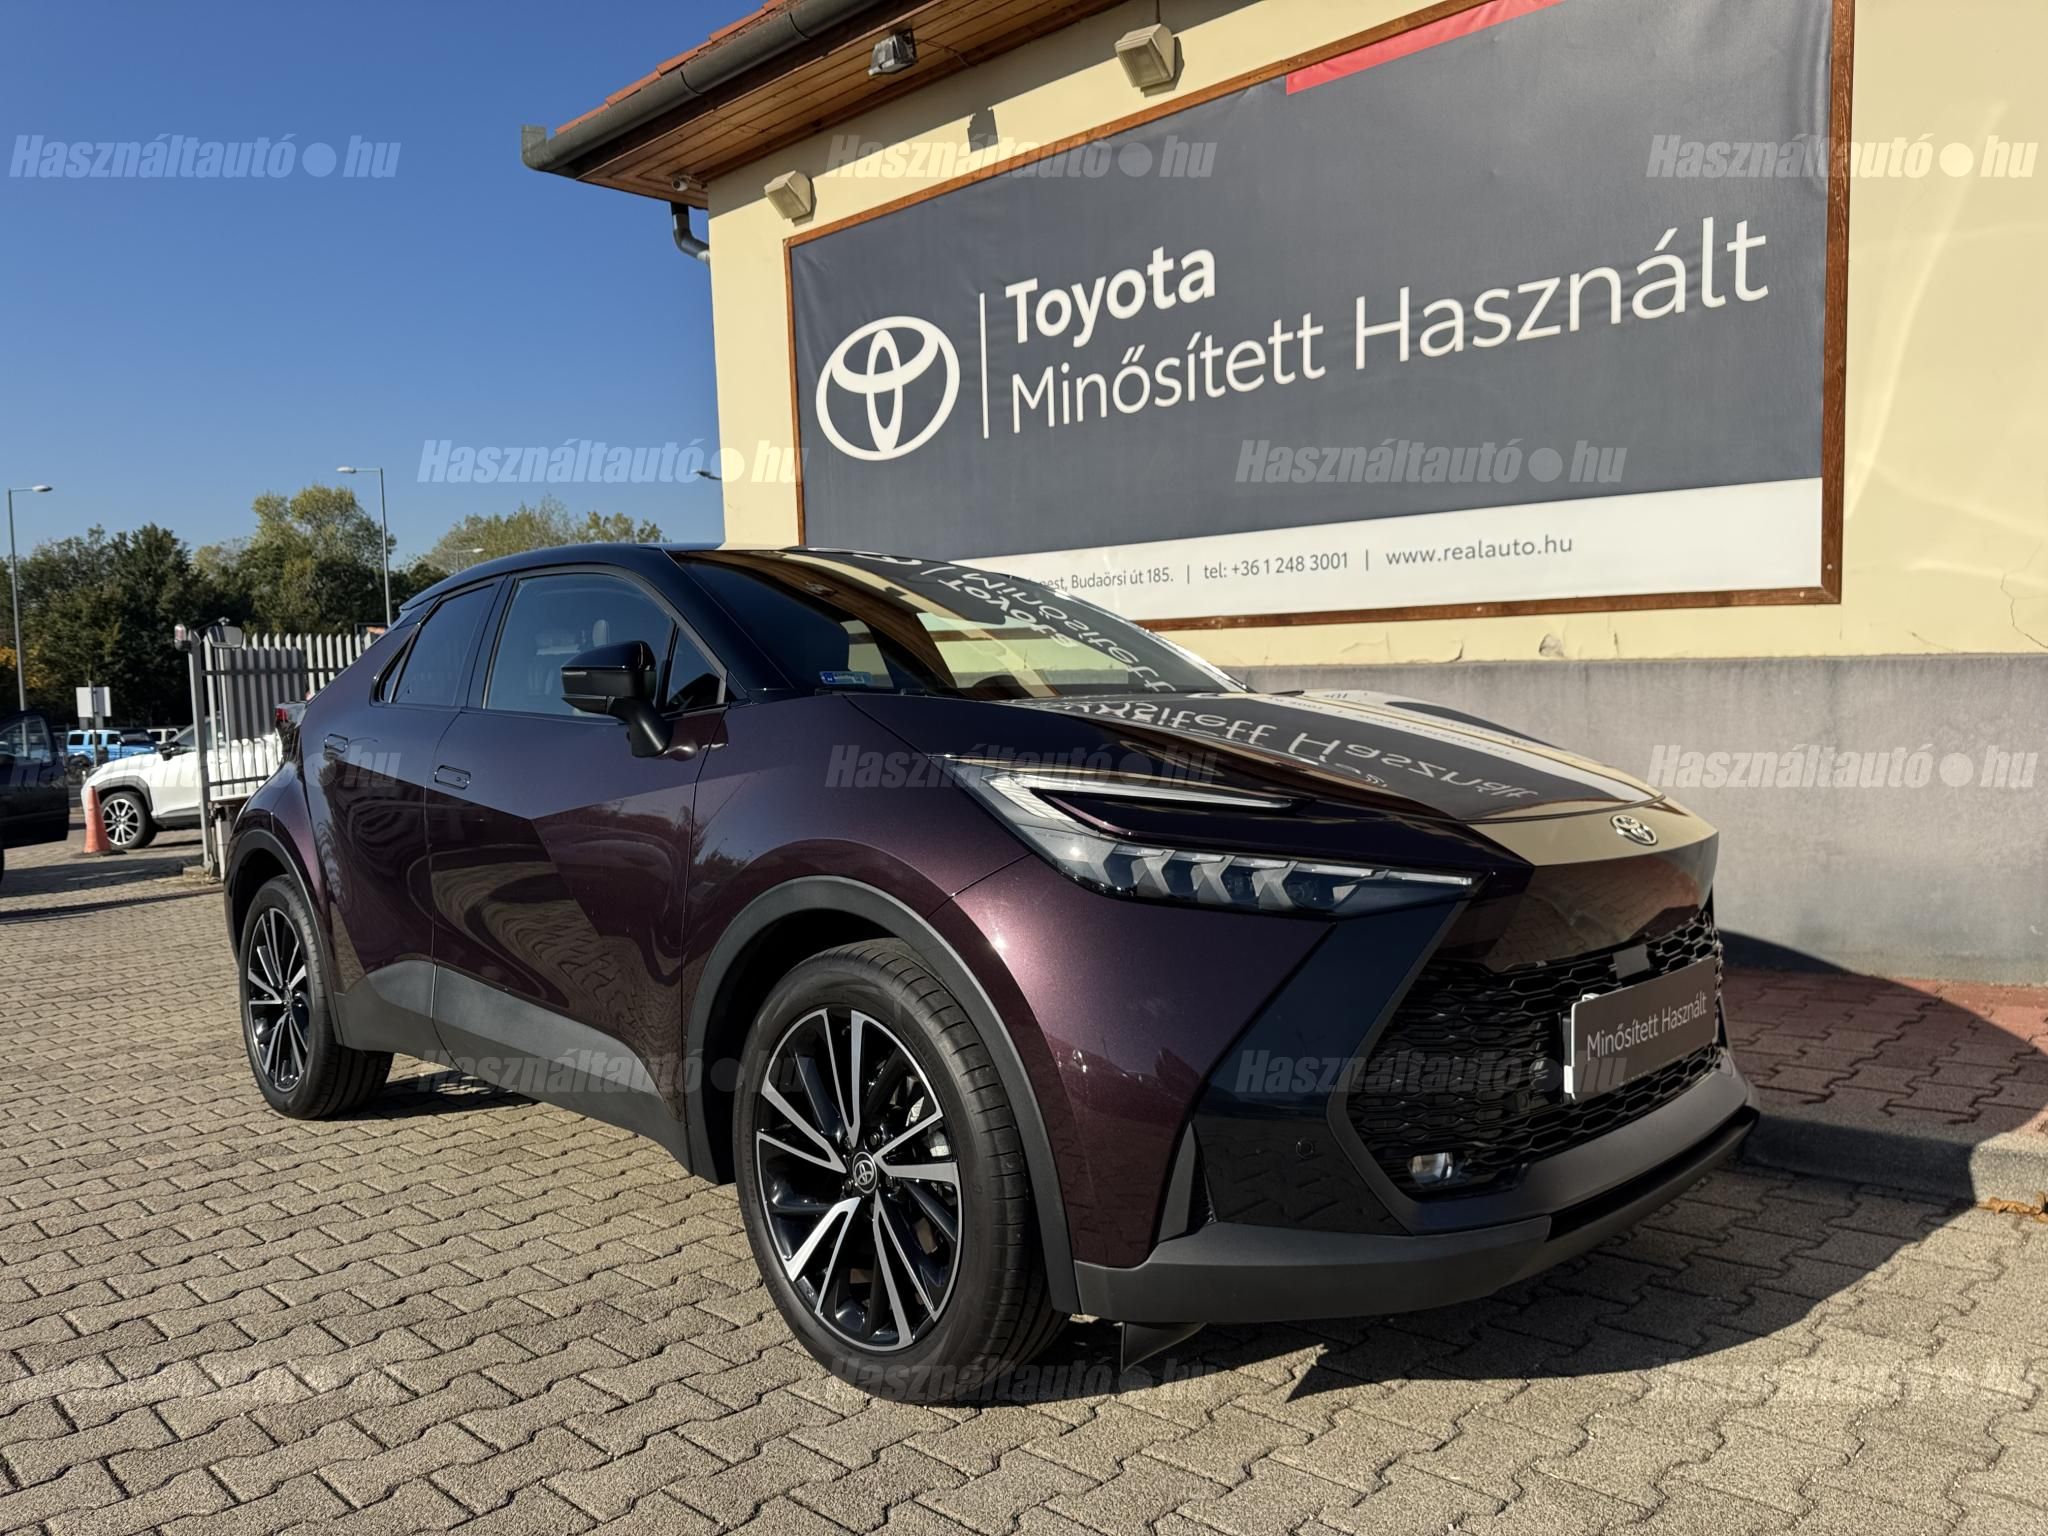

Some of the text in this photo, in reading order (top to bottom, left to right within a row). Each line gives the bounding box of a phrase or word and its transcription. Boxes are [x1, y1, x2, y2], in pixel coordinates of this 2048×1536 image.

[1004, 245, 1216, 347] Toyota
[1011, 216, 1769, 433] Minősített Használt
[1071, 572, 1127, 590] Budaörsi
[1130, 572, 1144, 586] út
[1148, 566, 1174, 584] 185.
[1204, 562, 1228, 579] tel:
[1275, 555, 1305, 574] 248
[1310, 552, 1348, 571] 3001
[1386, 534, 1573, 565] www.realauto.hu
[1586, 991, 1708, 1062] Minősített Használt
